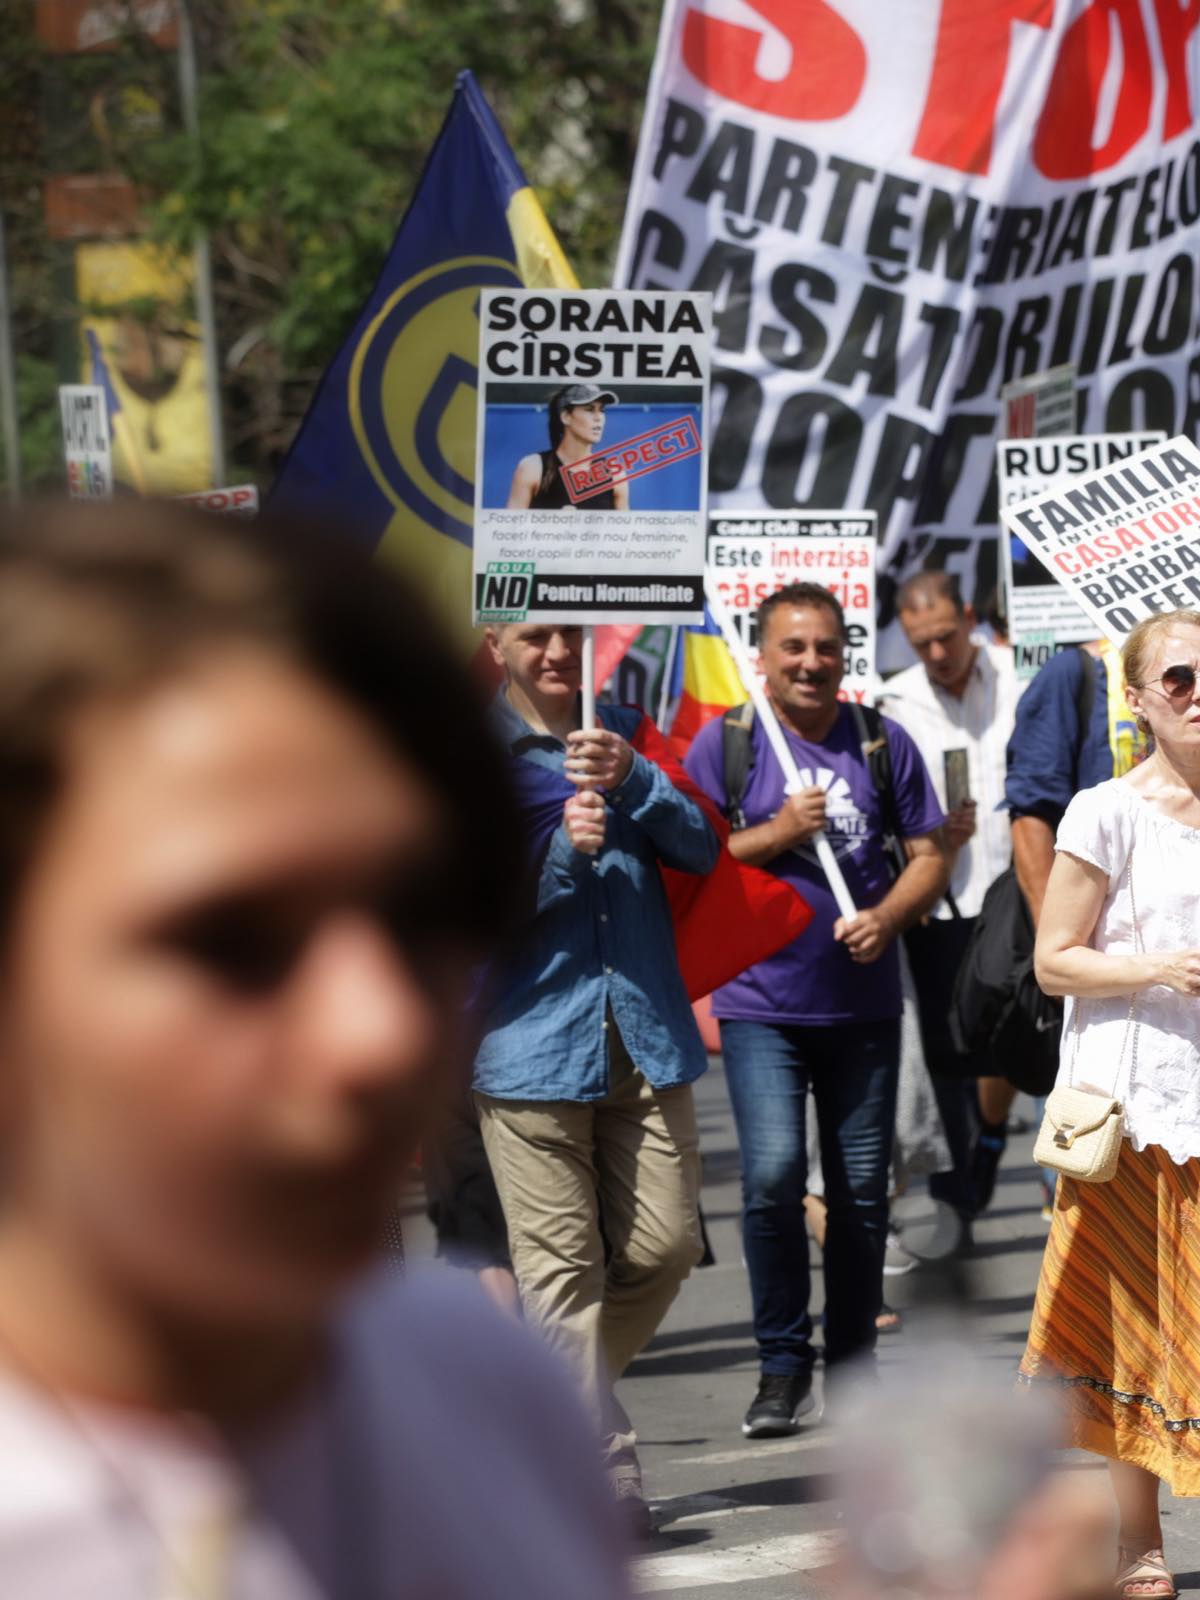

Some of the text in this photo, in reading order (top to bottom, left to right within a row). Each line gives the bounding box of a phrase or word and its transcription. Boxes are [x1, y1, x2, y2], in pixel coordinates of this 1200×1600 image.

[488, 297, 704, 332] SORANA
[486, 332, 703, 379] CÎRSTEA
[573, 427, 692, 492] RESPECT
[487, 563, 534, 574] NOUA
[715, 545, 762, 567] Este
[484, 576, 529, 609] ND
[537, 583, 694, 603] Pentru Normalitate
[1105, 605, 1138, 633] O
